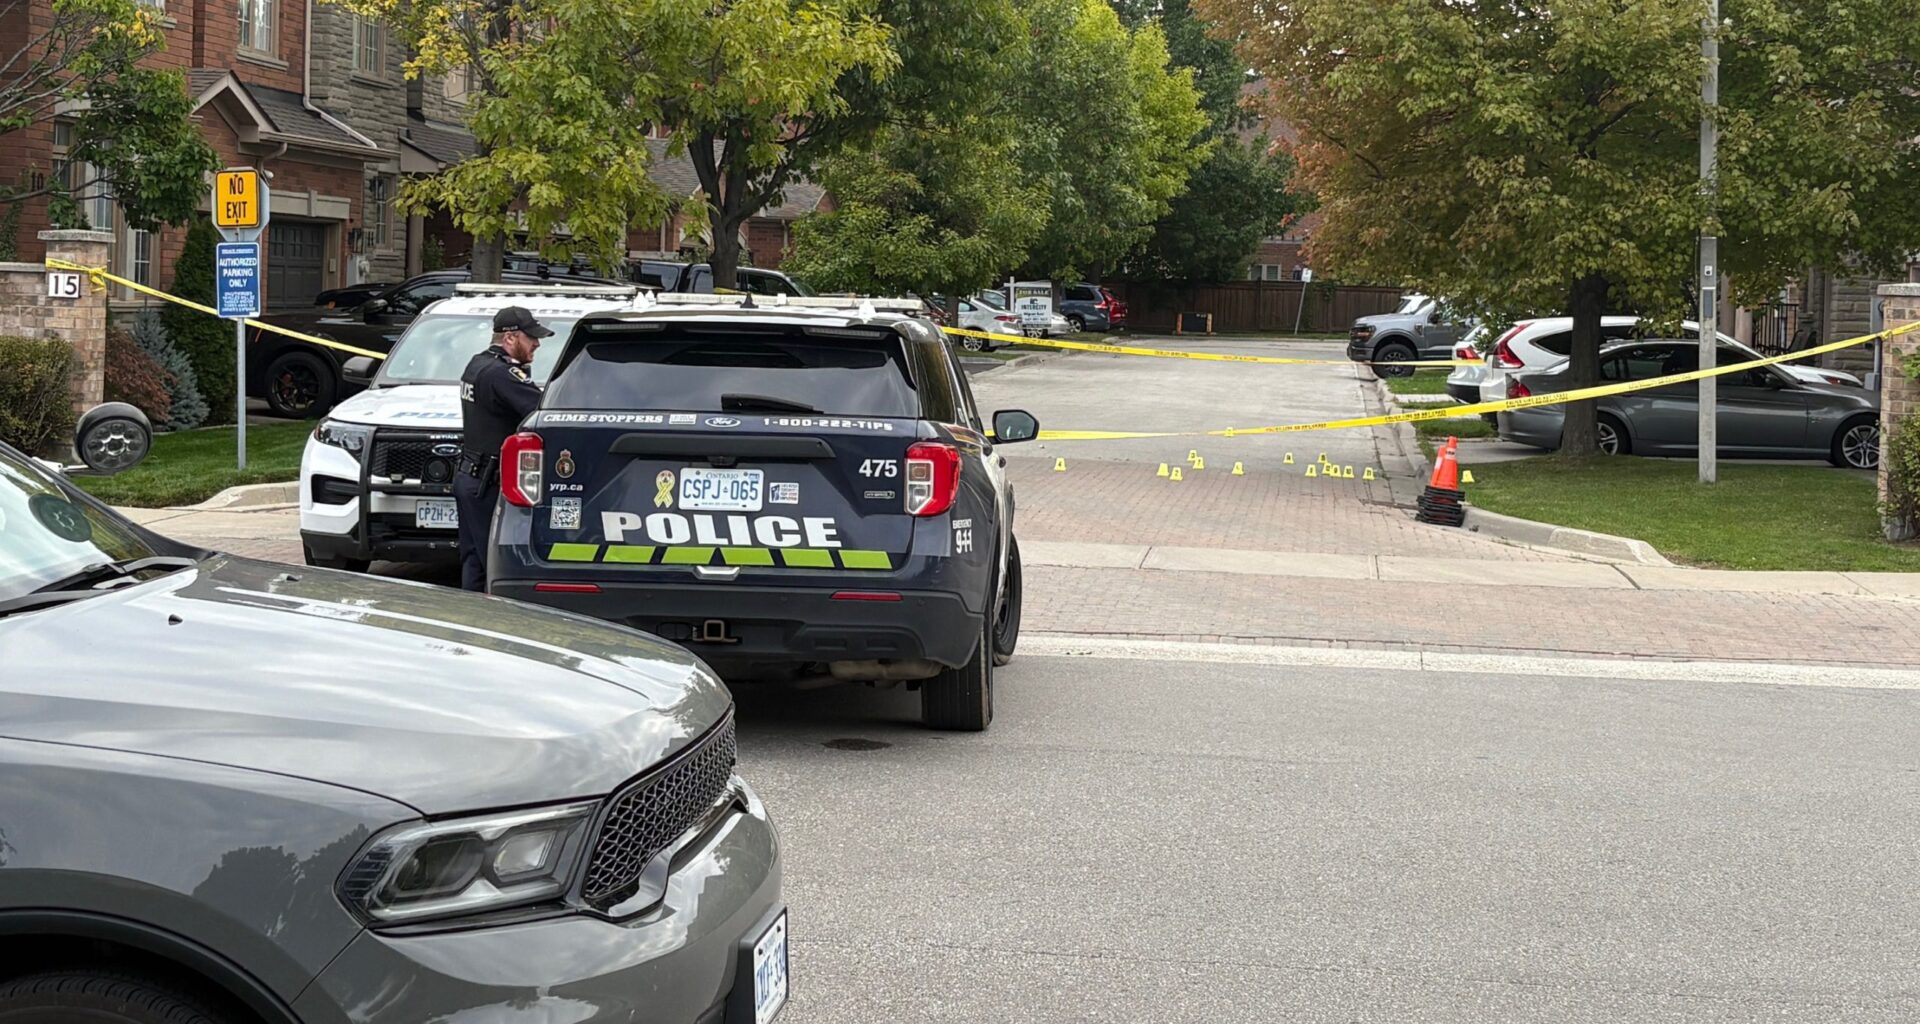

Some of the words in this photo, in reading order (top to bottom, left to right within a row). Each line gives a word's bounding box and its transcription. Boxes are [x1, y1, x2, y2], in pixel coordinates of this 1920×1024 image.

[230, 177, 244, 195] NO
[226, 201, 247, 219] EXIT
[219, 258, 257, 267] AUTHORIZED
[223, 268, 254, 277] PARKING
[53, 275, 78, 296] 15
[229, 278, 248, 288] ONLY
[543, 413, 588, 422] CRIME
[588, 414, 663, 424] STOPPERS
[763, 418, 893, 431] 1-800-222-TIPS
[858, 459, 898, 478] 475
[705, 471, 739, 479] ONTARIO
[549, 483, 584, 492] yrp.ca
[601, 511, 842, 548] POLICE
